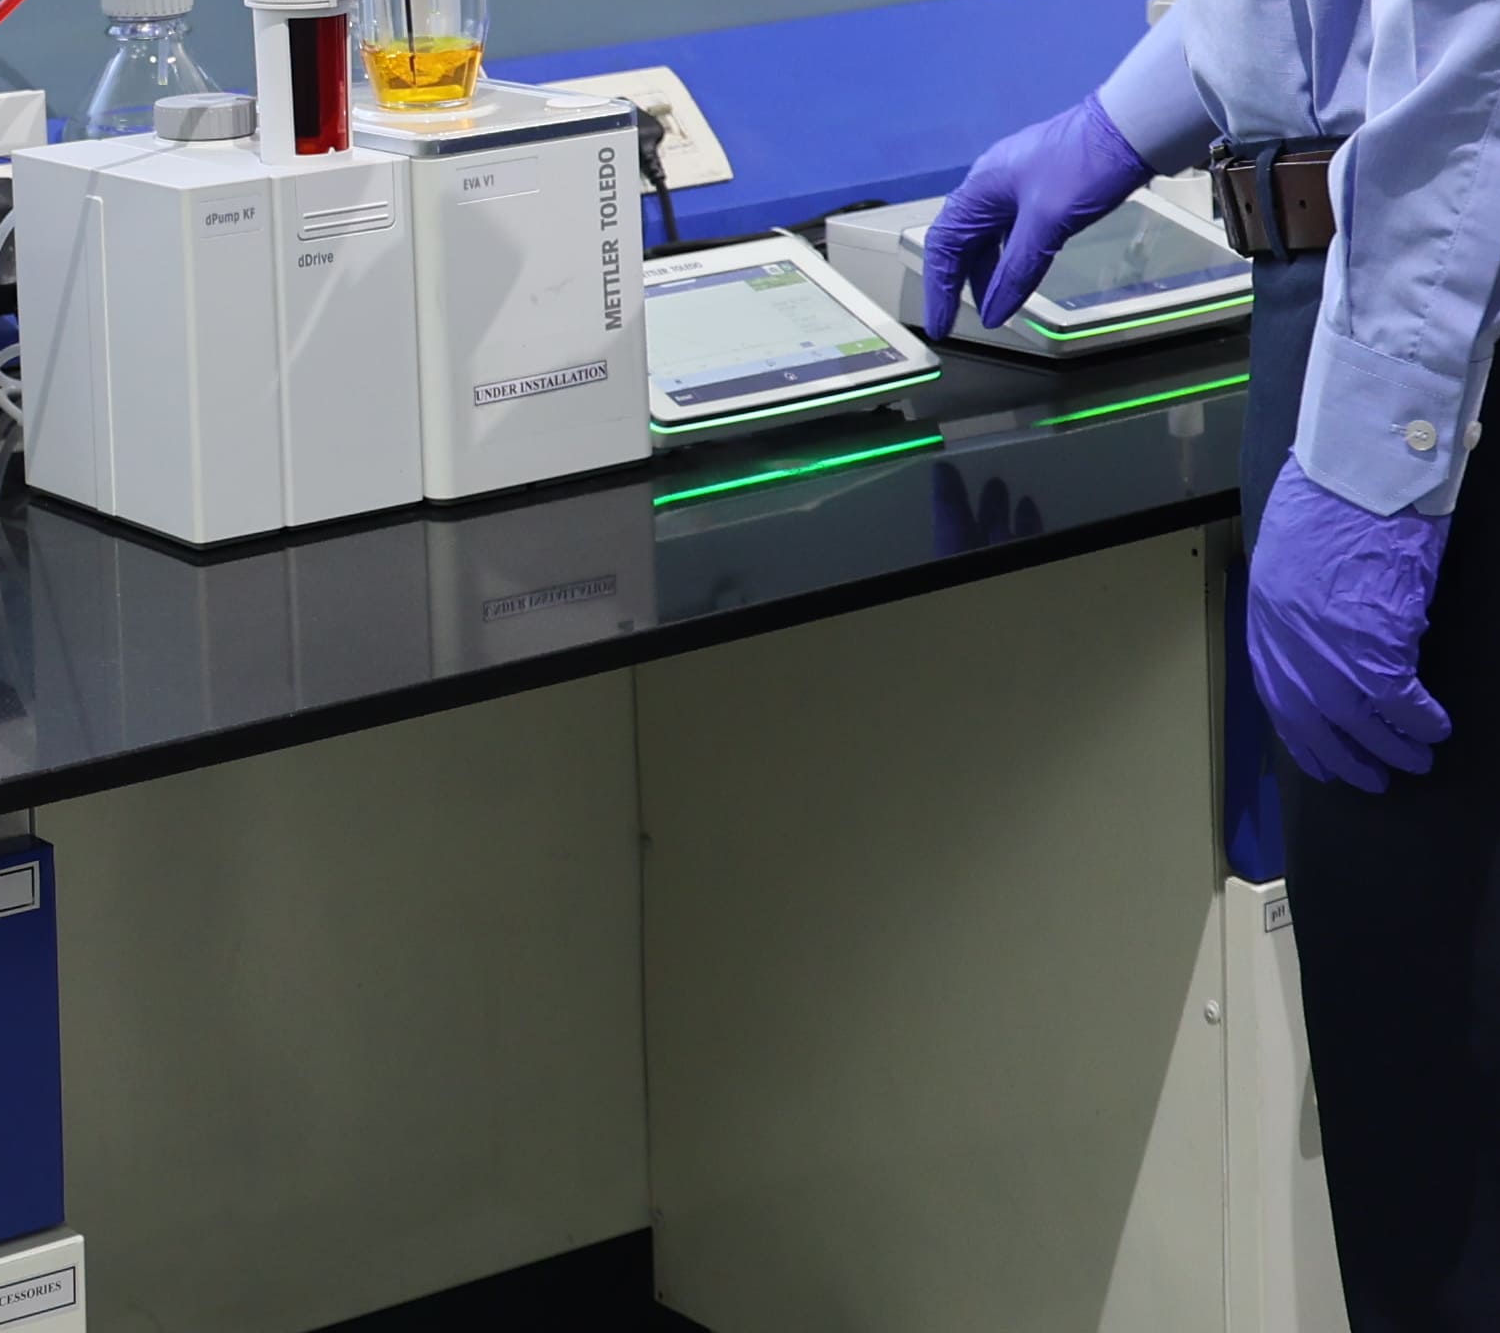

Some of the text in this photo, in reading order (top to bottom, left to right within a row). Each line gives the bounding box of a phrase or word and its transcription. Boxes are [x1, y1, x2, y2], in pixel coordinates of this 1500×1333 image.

[463, 174, 495, 192] EVA V1
[205, 206, 257, 228] dPump KF
[598, 146, 623, 332] METTLER TOLEDO
[298, 251, 335, 269] dDrive
[475, 364, 608, 403] UNDER INSTALLATION
[1271, 903, 1286, 923] pH
